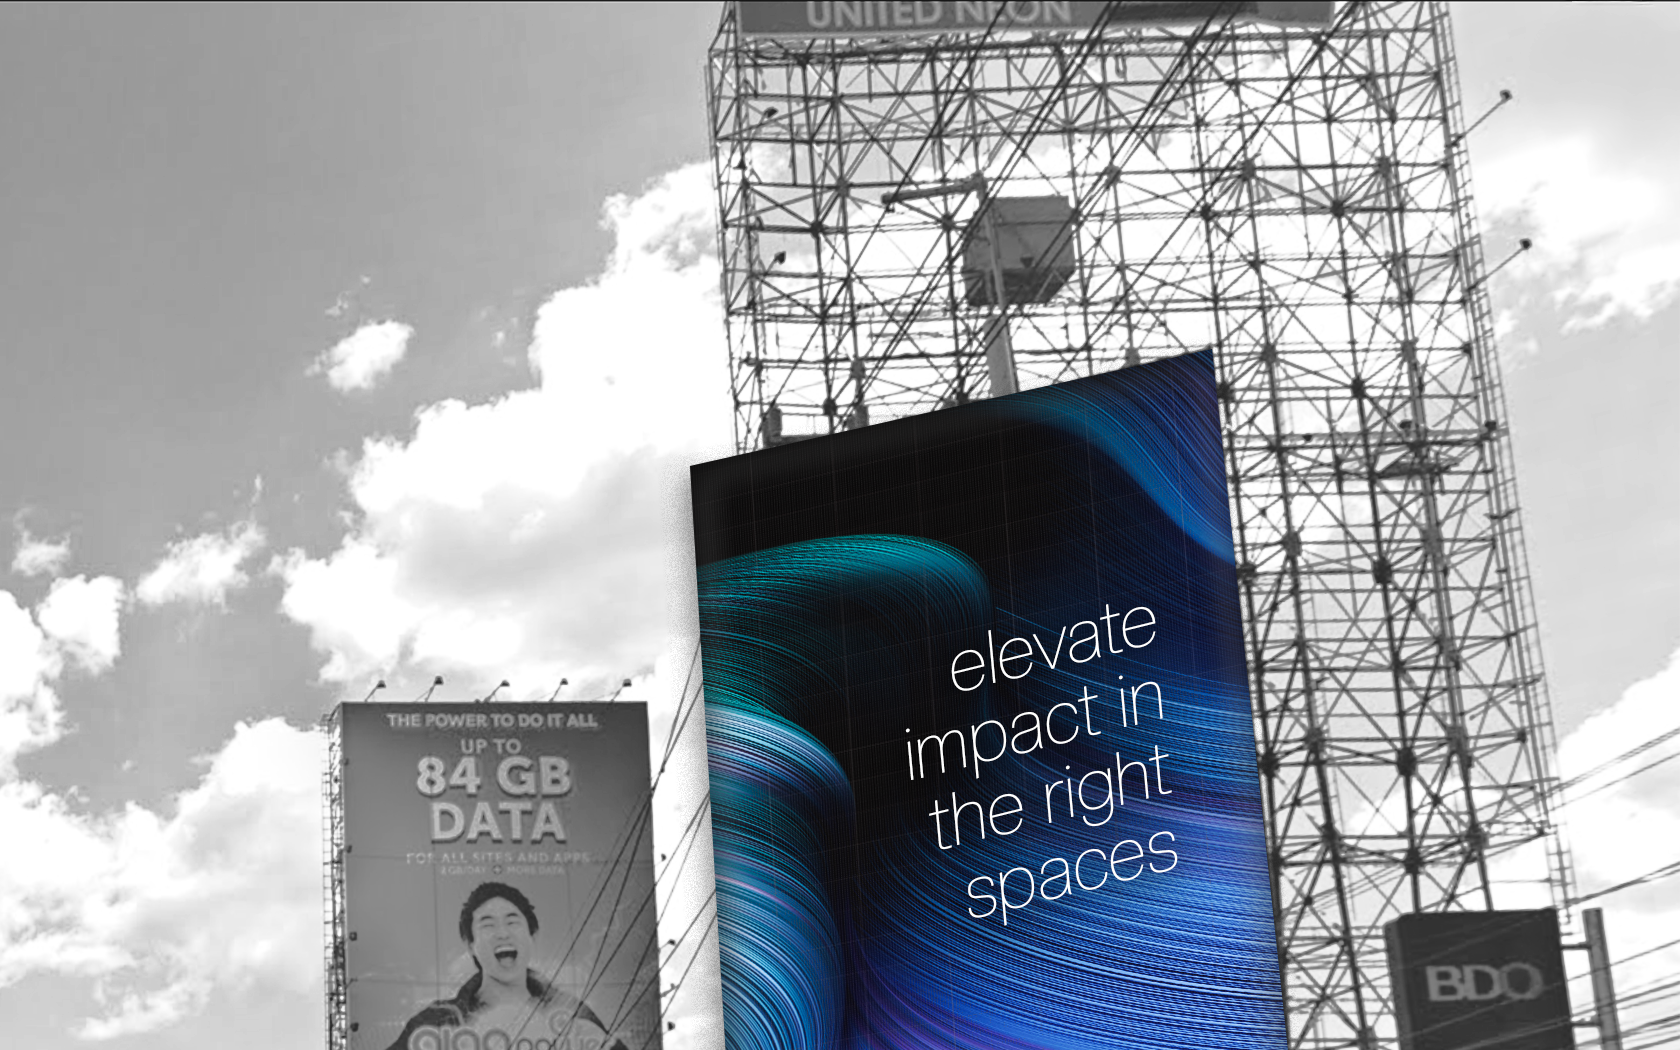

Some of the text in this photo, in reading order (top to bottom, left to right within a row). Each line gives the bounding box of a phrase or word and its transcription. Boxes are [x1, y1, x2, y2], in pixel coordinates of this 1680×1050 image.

[806, 2, 1072, 28] UNITED NEON
[951, 603, 1156, 691] elevate
[386, 713, 598, 728] THE POWER TO DO IT ALL
[905, 675, 1163, 780] impact in
[460, 738, 522, 754] UP TO
[416, 755, 572, 797] 84 GB
[929, 745, 1173, 850] the right
[431, 801, 567, 844] DATA
[440, 853, 468, 864] ALL
[472, 853, 513, 864] SITES
[516, 853, 550, 864] AND
[553, 853, 591, 864] APPS
[967, 831, 1178, 926] spaces
[1424, 961, 1545, 1003] BDO
